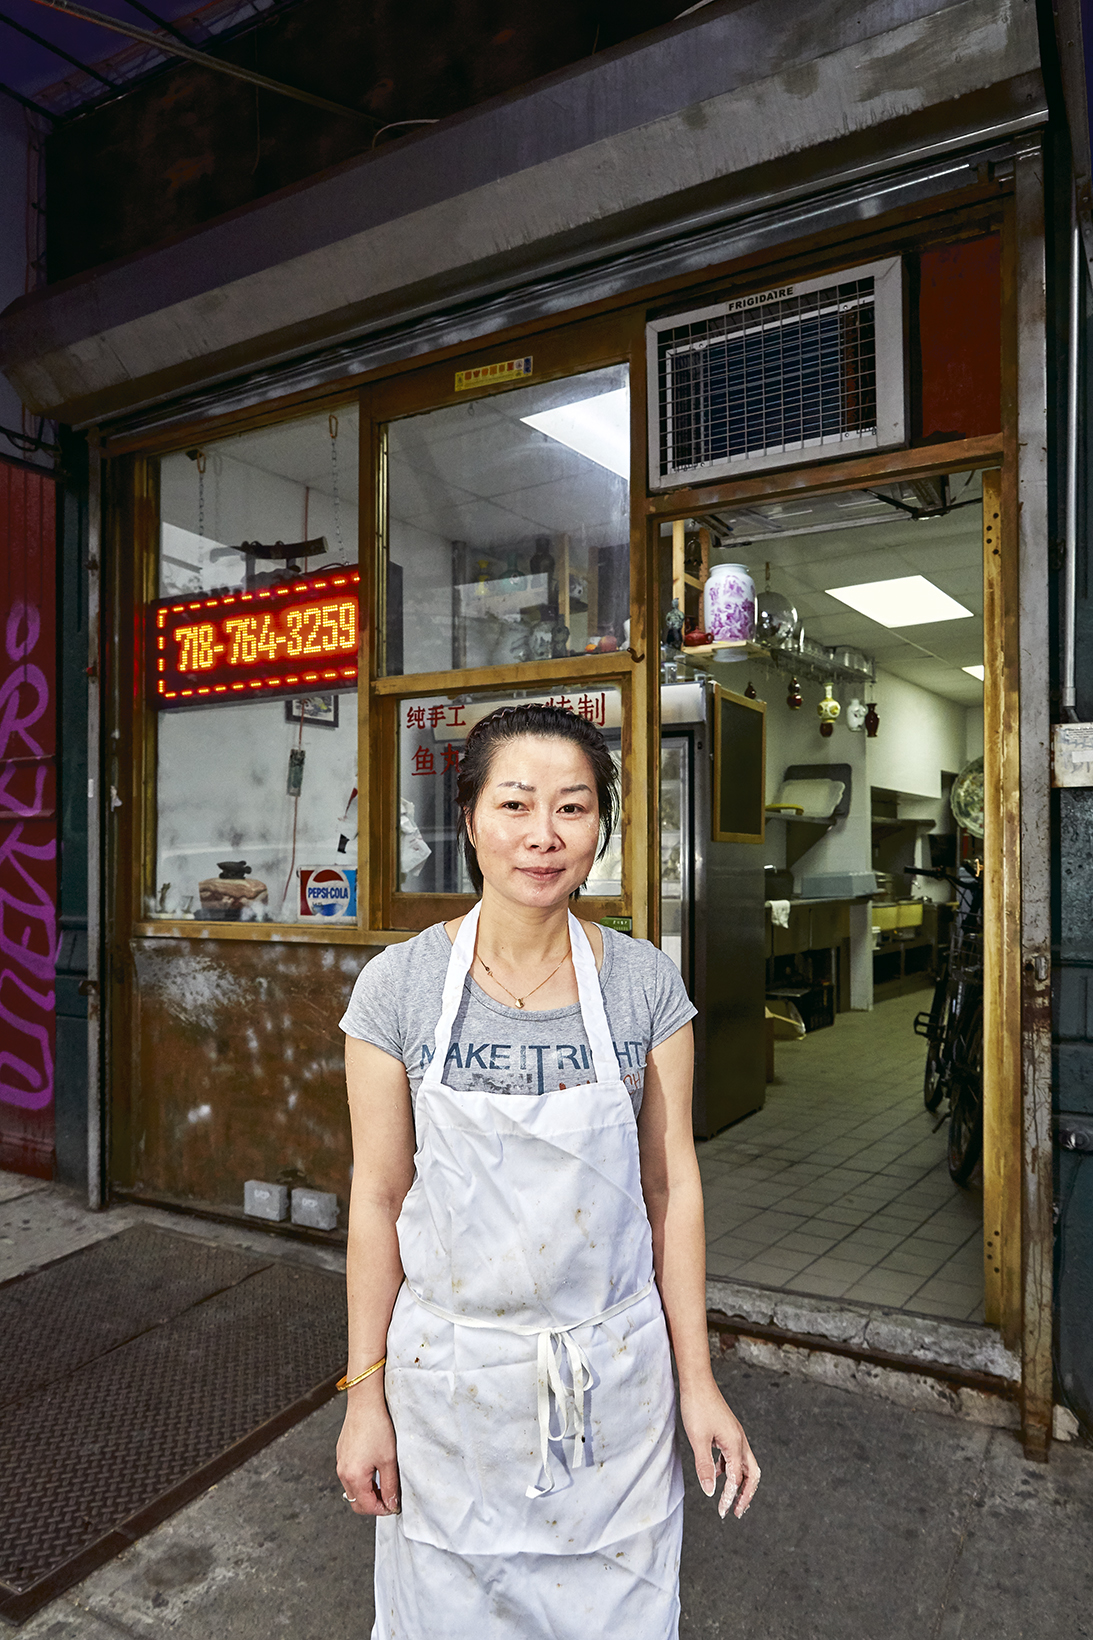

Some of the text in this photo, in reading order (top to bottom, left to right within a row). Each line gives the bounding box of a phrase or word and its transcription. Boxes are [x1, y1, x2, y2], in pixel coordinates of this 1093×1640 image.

[728, 286, 794, 311] FRIGIDAIRE
[175, 601, 356, 672] 718-764-3259
[406, 704, 467, 730] 纯手工
[411, 743, 461, 776] 鱼丸
[308, 887, 349, 899] PEPSI-COLA
[420, 1041, 642, 1095] MAKE IT RIHT
